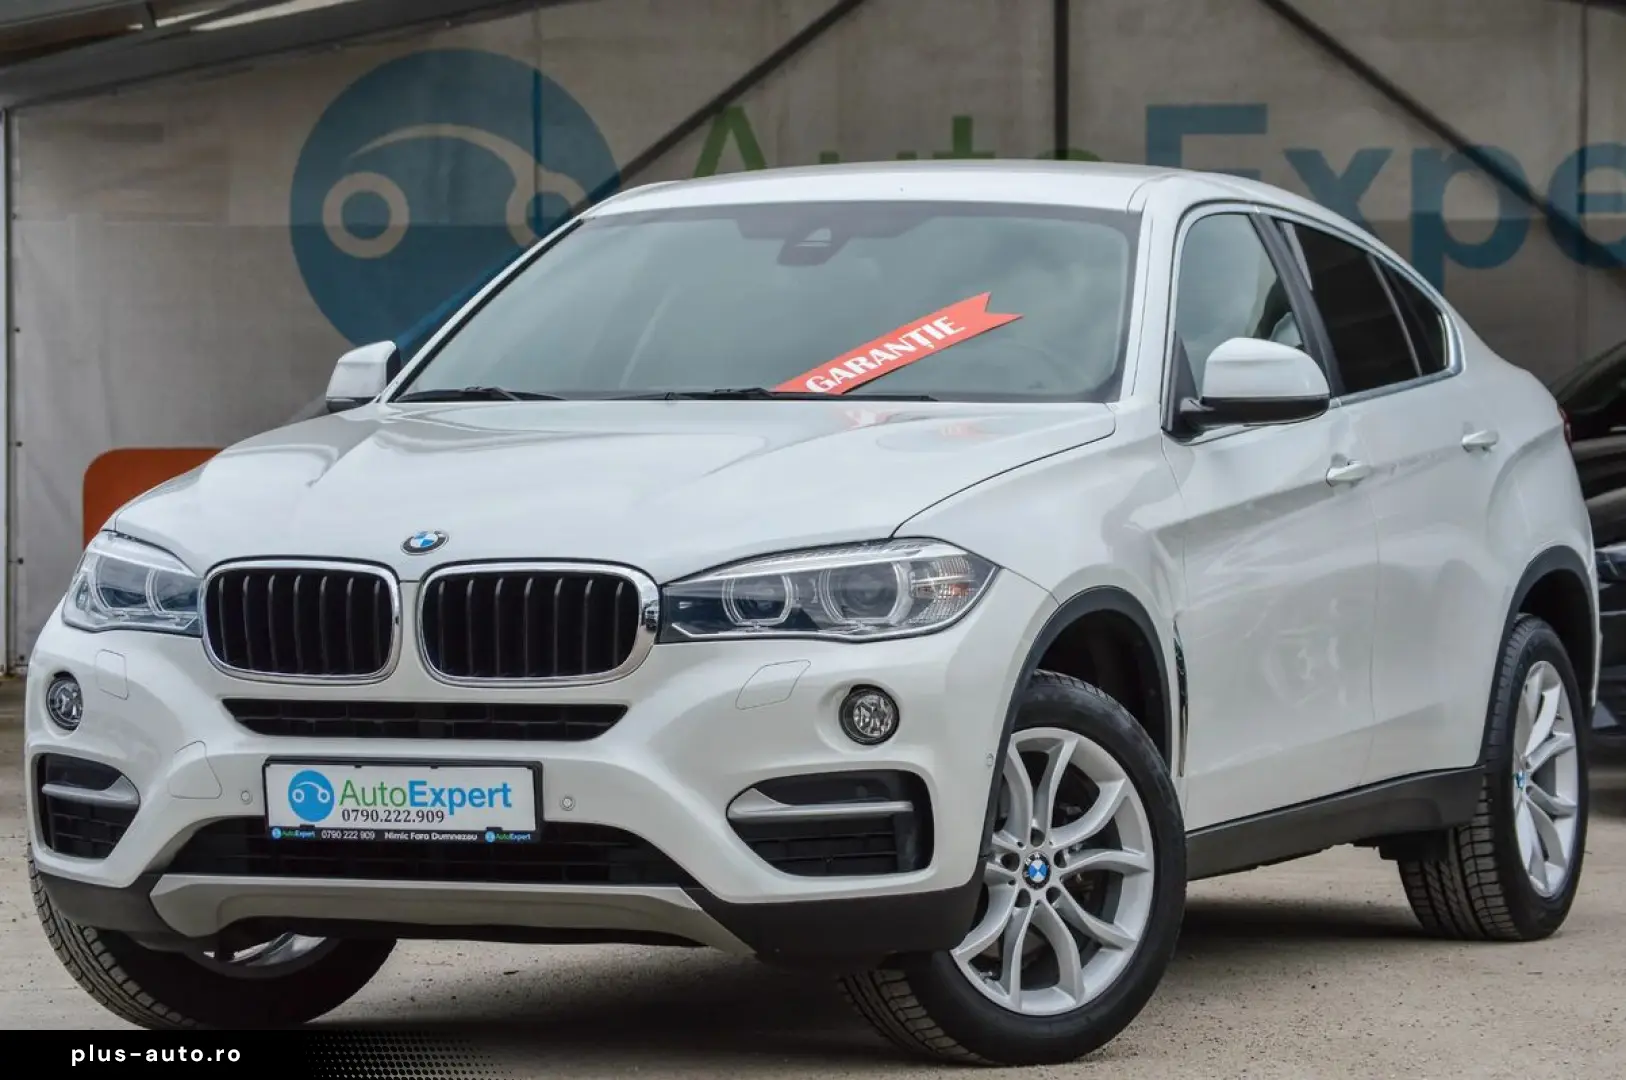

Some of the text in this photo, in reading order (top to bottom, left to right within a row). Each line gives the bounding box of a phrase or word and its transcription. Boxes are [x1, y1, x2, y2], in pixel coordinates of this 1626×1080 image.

[338, 779, 512, 815] AutoExpert
[341, 808, 445, 823] 0790.222.909
[321, 830, 341, 839] 0790
[343, 830, 358, 839] 222
[360, 831, 375, 840] 909
[384, 831, 408, 840] Nimic
